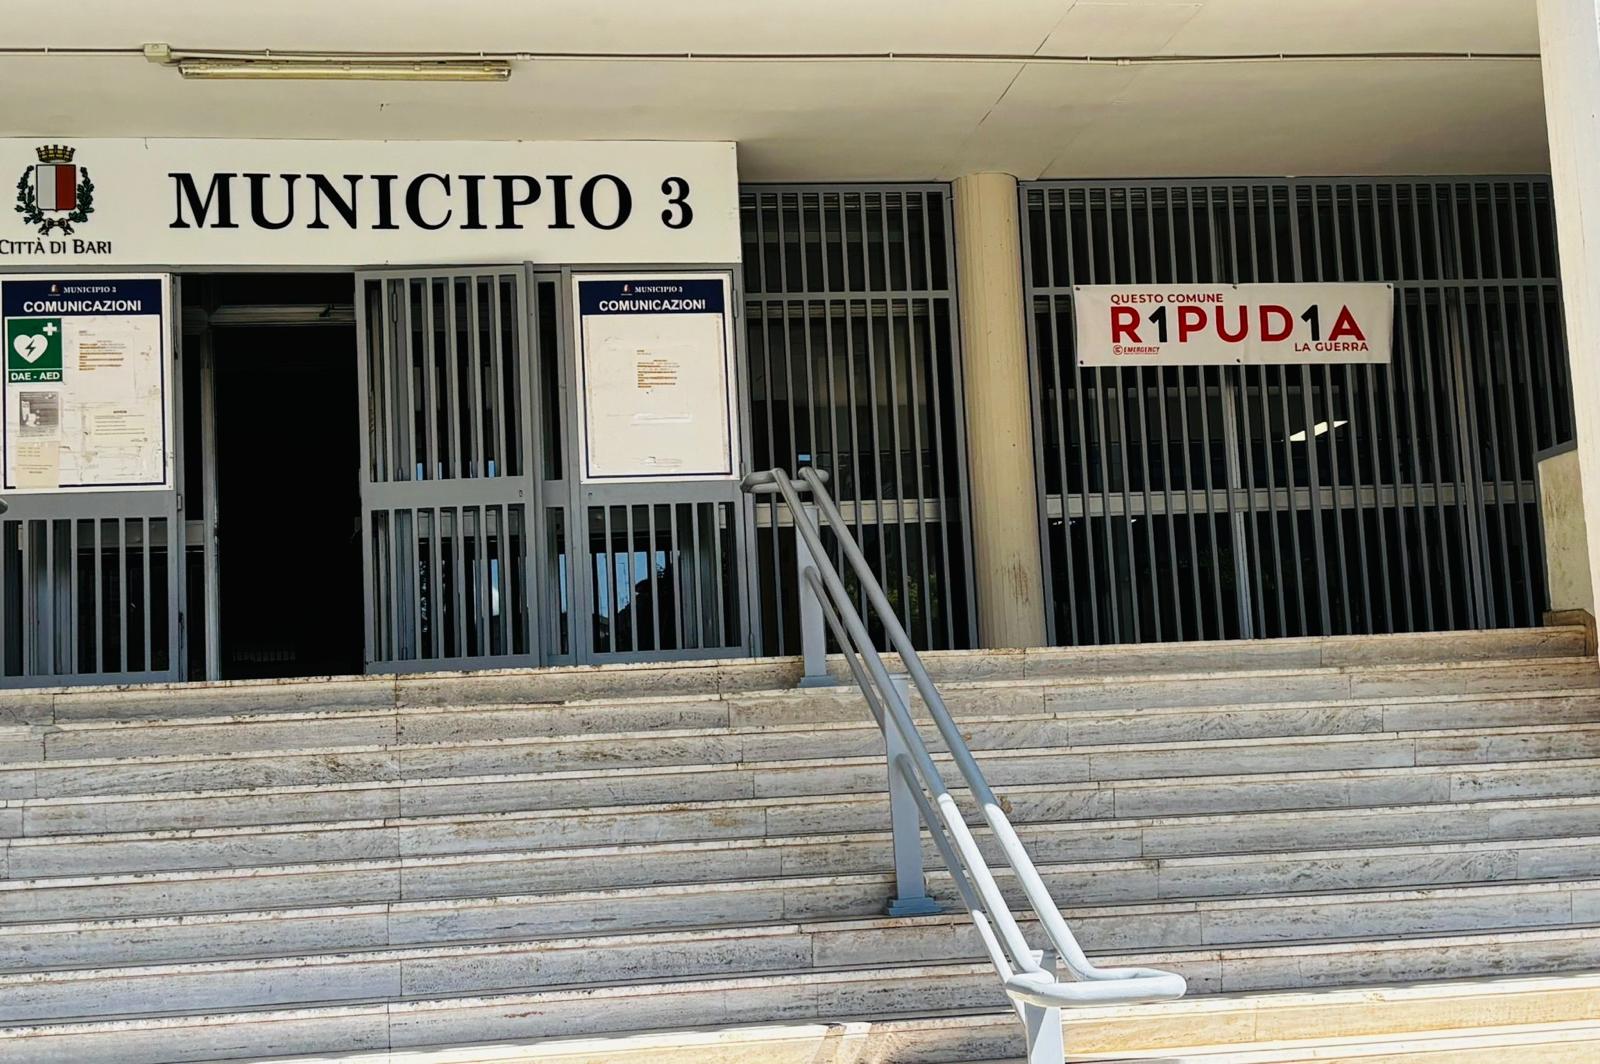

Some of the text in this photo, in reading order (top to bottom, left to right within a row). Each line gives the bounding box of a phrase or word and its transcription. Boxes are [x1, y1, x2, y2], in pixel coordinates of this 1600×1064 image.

[167, 172, 694, 231] MUNICIPIO 3
[63, 286, 111, 294] MUNICIPIO
[599, 299, 706, 312] COMUNICAZIONI
[1110, 293, 1224, 306] QUESTO COMUNE
[23, 300, 141, 313] COMUNICAZIONI
[1110, 303, 1367, 344] R1PUD1A
[1294, 342, 1369, 352] LA GUERRA
[11, 372, 31, 381] DAE
[40, 371, 61, 380] AED
